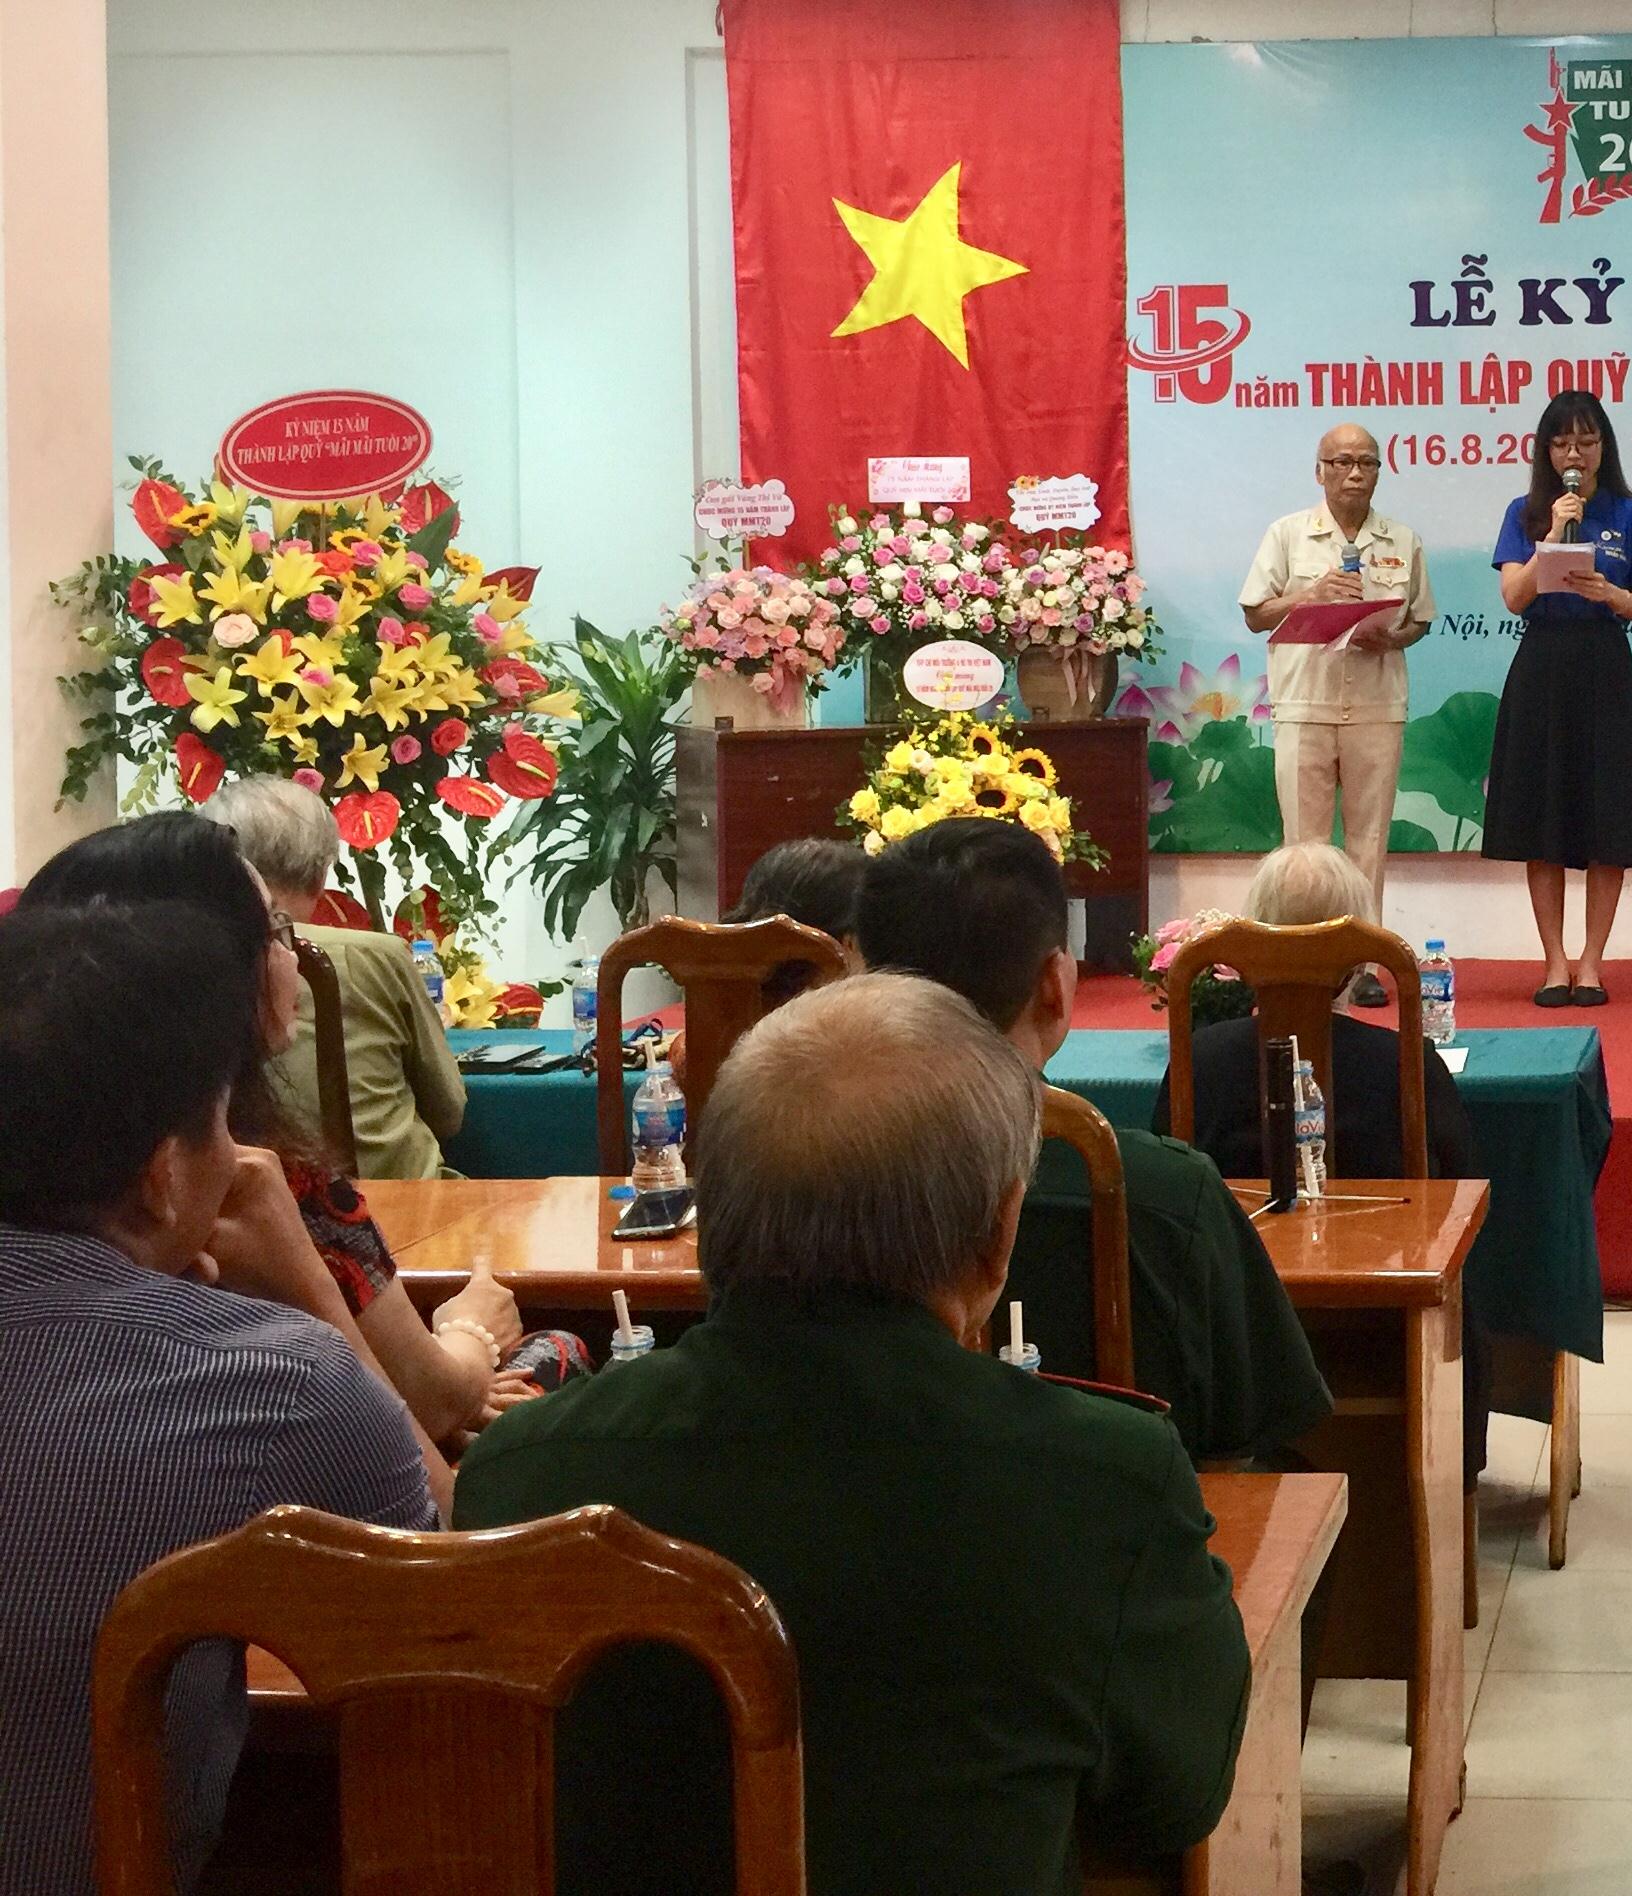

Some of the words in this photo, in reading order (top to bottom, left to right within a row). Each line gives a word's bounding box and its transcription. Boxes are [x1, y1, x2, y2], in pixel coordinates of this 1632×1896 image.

[1574, 65, 1622, 90] MÃI
[1408, 253, 1496, 327] LỄ
[1517, 257, 1625, 326] KỶ
[1234, 375, 1300, 409] năm
[1305, 354, 1444, 408] THÀNH
[1459, 352, 1533, 414] LẬP
[1547, 351, 1631, 403] QUỸ
[237, 443, 276, 465] THÀNH
[1387, 433, 1536, 473] (16.8.20
[1440, 613, 1489, 641] Nội,
[1498, 619, 1527, 641] ng
